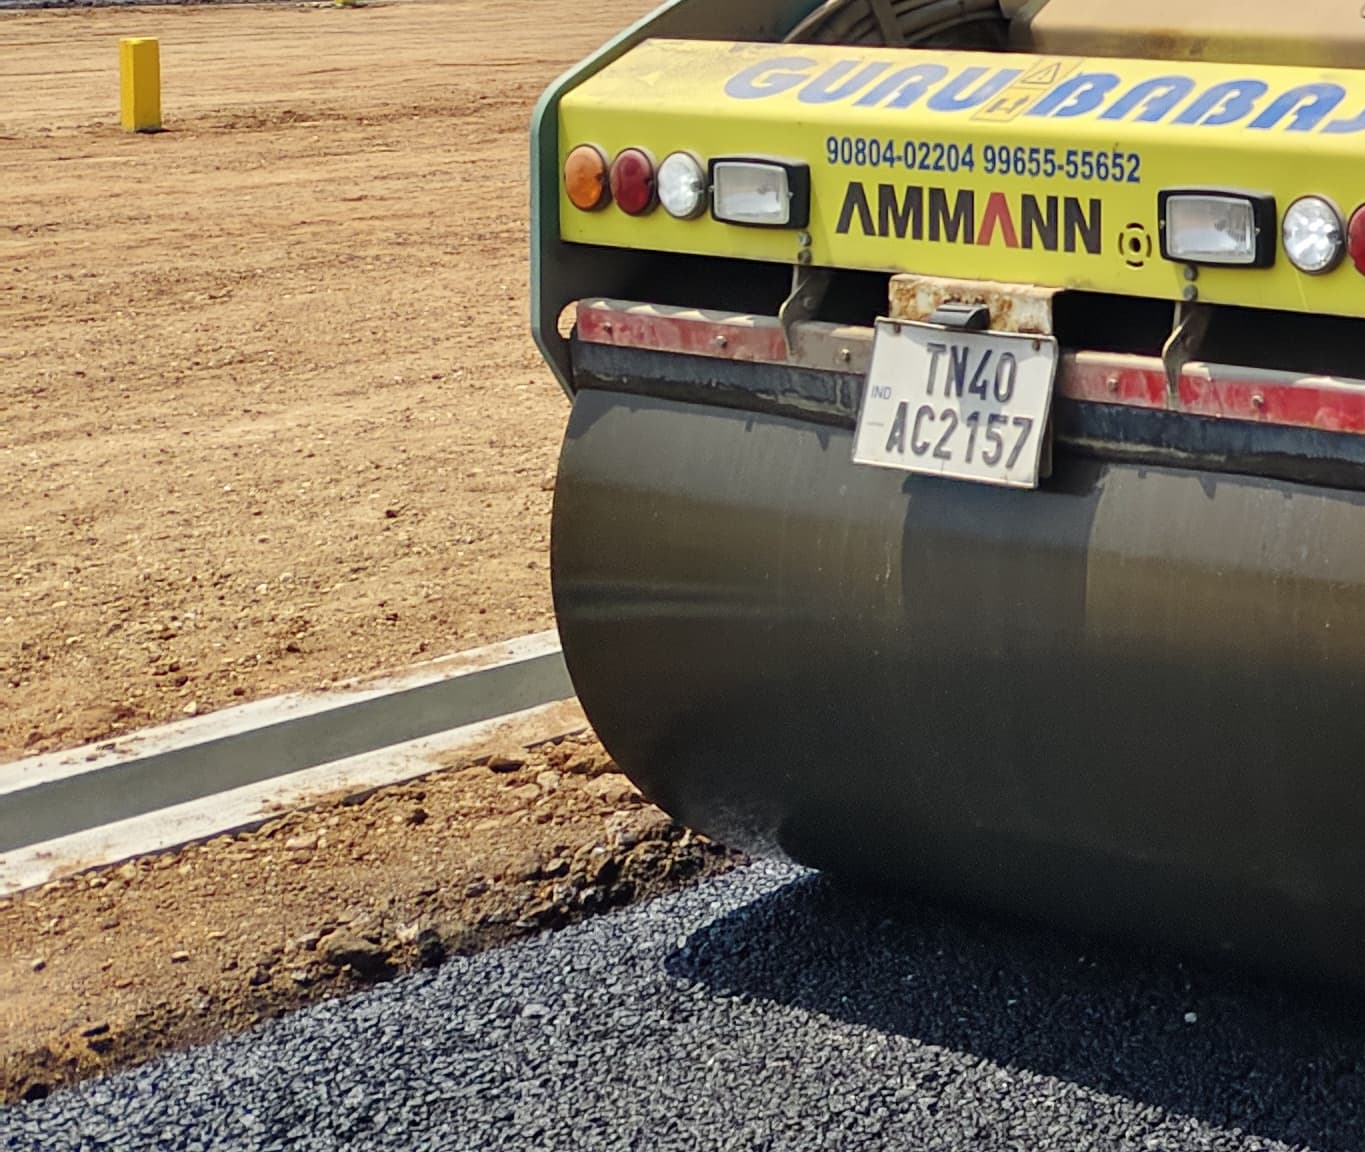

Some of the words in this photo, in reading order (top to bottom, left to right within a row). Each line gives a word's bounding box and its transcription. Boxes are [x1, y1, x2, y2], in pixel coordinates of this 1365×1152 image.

[723, 56, 1024, 112] GURU
[826, 136, 975, 172] 90804-02204
[983, 144, 1141, 183] 99655-55652
[836, 181, 1102, 255] AMMANN
[871, 385, 892, 400] IND
[926, 342, 1017, 402] TN40
[886, 401, 1034, 469] AC2157
